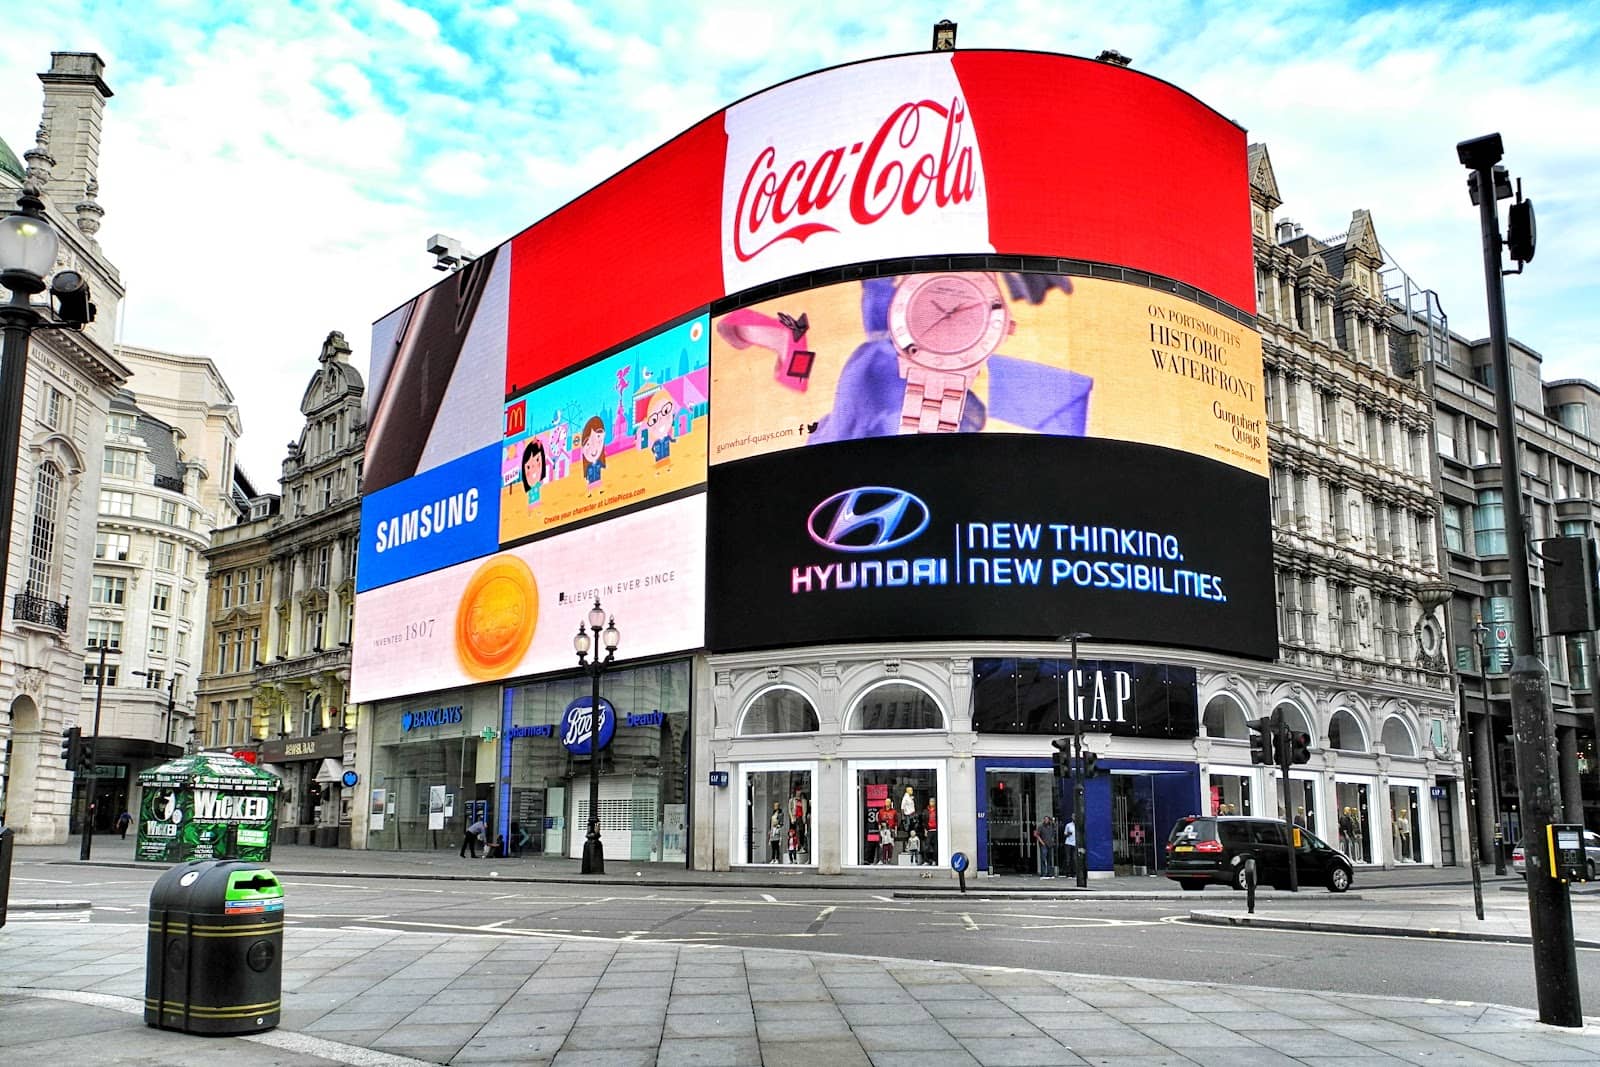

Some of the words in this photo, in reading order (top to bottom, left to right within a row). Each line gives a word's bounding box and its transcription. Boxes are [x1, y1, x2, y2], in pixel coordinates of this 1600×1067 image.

[734, 96, 976, 262] Coca-Cola
[1148, 304, 1166, 320] ON
[1169, 309, 1241, 349] PORTSMOUTH'S
[1150, 323, 1227, 366] HISTORIC
[1151, 349, 1255, 402] WATERFRONT
[1213, 400, 1261, 434] Gunwharf
[716, 428, 793, 454] gunwharf-quays.com
[1232, 425, 1261, 450] Quays
[376, 487, 479, 553] SAMSUNG
[561, 511, 572, 521] your
[573, 503, 597, 517] character
[968, 522, 1041, 550] NEW
[1049, 524, 1184, 561] THINKING.
[603, 585, 613, 596] IN
[617, 578, 641, 593] EVER
[644, 571, 676, 588] SINCE
[792, 558, 947, 594] HYUNDAI
[969, 558, 1042, 584] NEW
[1052, 558, 1227, 602] POSSIBILITIES.
[373, 634, 402, 648] INVENTED
[405, 618, 436, 641] 1807
[1067, 668, 1131, 722] GAP
[413, 705, 462, 728] BARCLAYS
[508, 724, 553, 740] pharmacy
[563, 705, 606, 745] Boos
[626, 709, 666, 728] beauty
